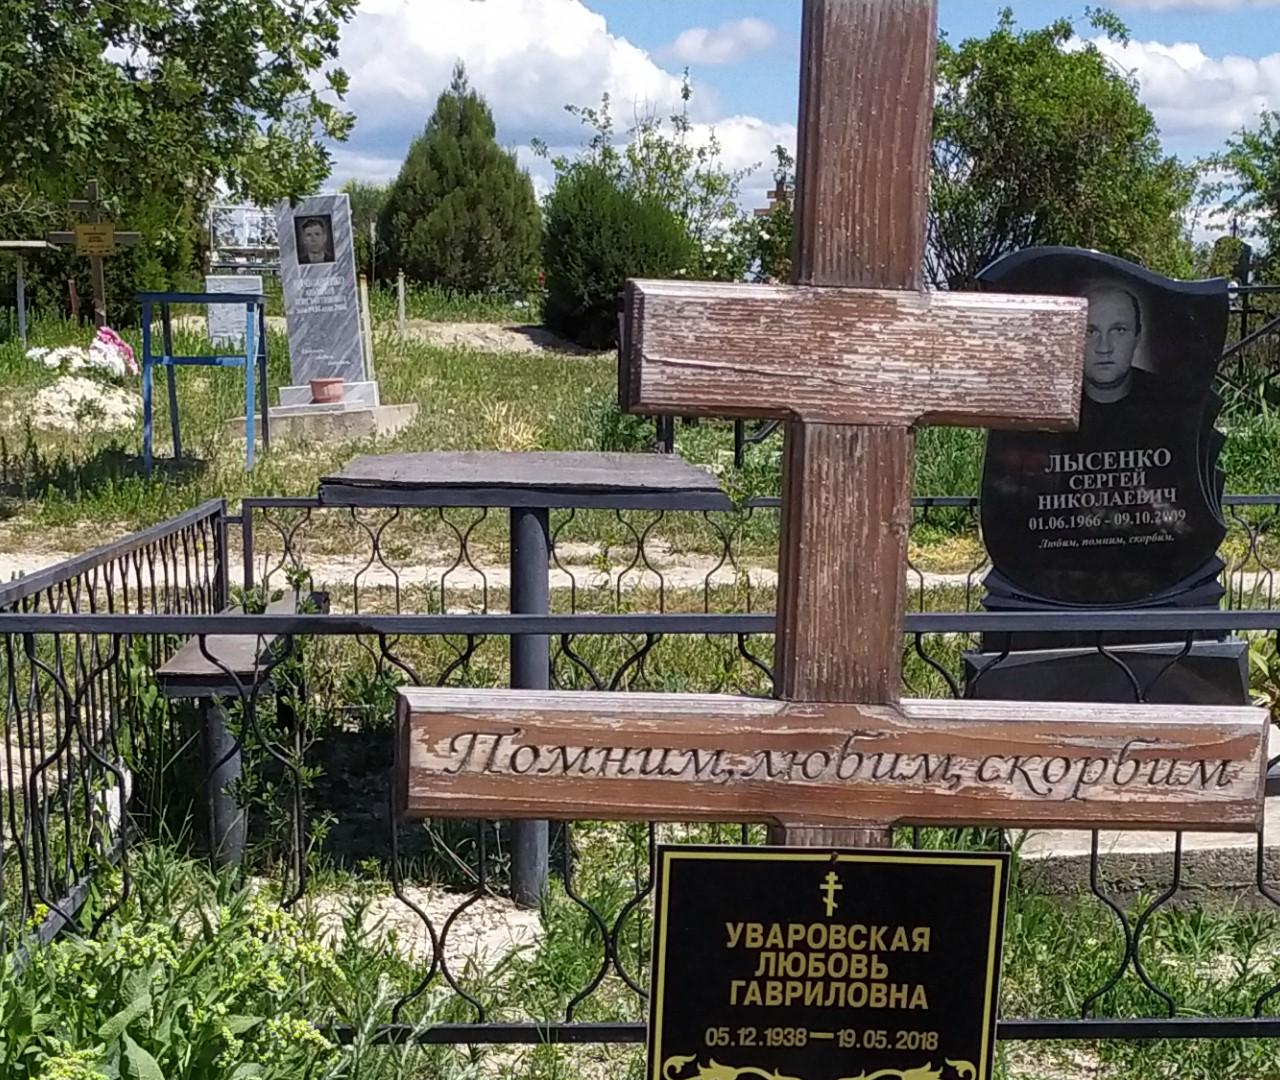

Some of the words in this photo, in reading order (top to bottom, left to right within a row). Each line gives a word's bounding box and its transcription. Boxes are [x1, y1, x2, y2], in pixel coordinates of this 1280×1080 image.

[1045, 448, 1171, 473] ЛЫСЕНКО
[1069, 468, 1146, 490] СЕРГЕЙ
[1038, 487, 1177, 510] НИКОЛАЕВИЧ
[1028, 515, 1102, 531] 01.06.1966
[1038, 538, 1079, 549] Любим,
[1081, 536, 1126, 547] помним,
[974, 738, 1232, 800] скорбим
[725, 922, 931, 952] УВАРОВСКАЯ
[754, 951, 889, 980] ЛЮБОВЬ
[730, 980, 929, 1010] ГАВРИЛОВНА
